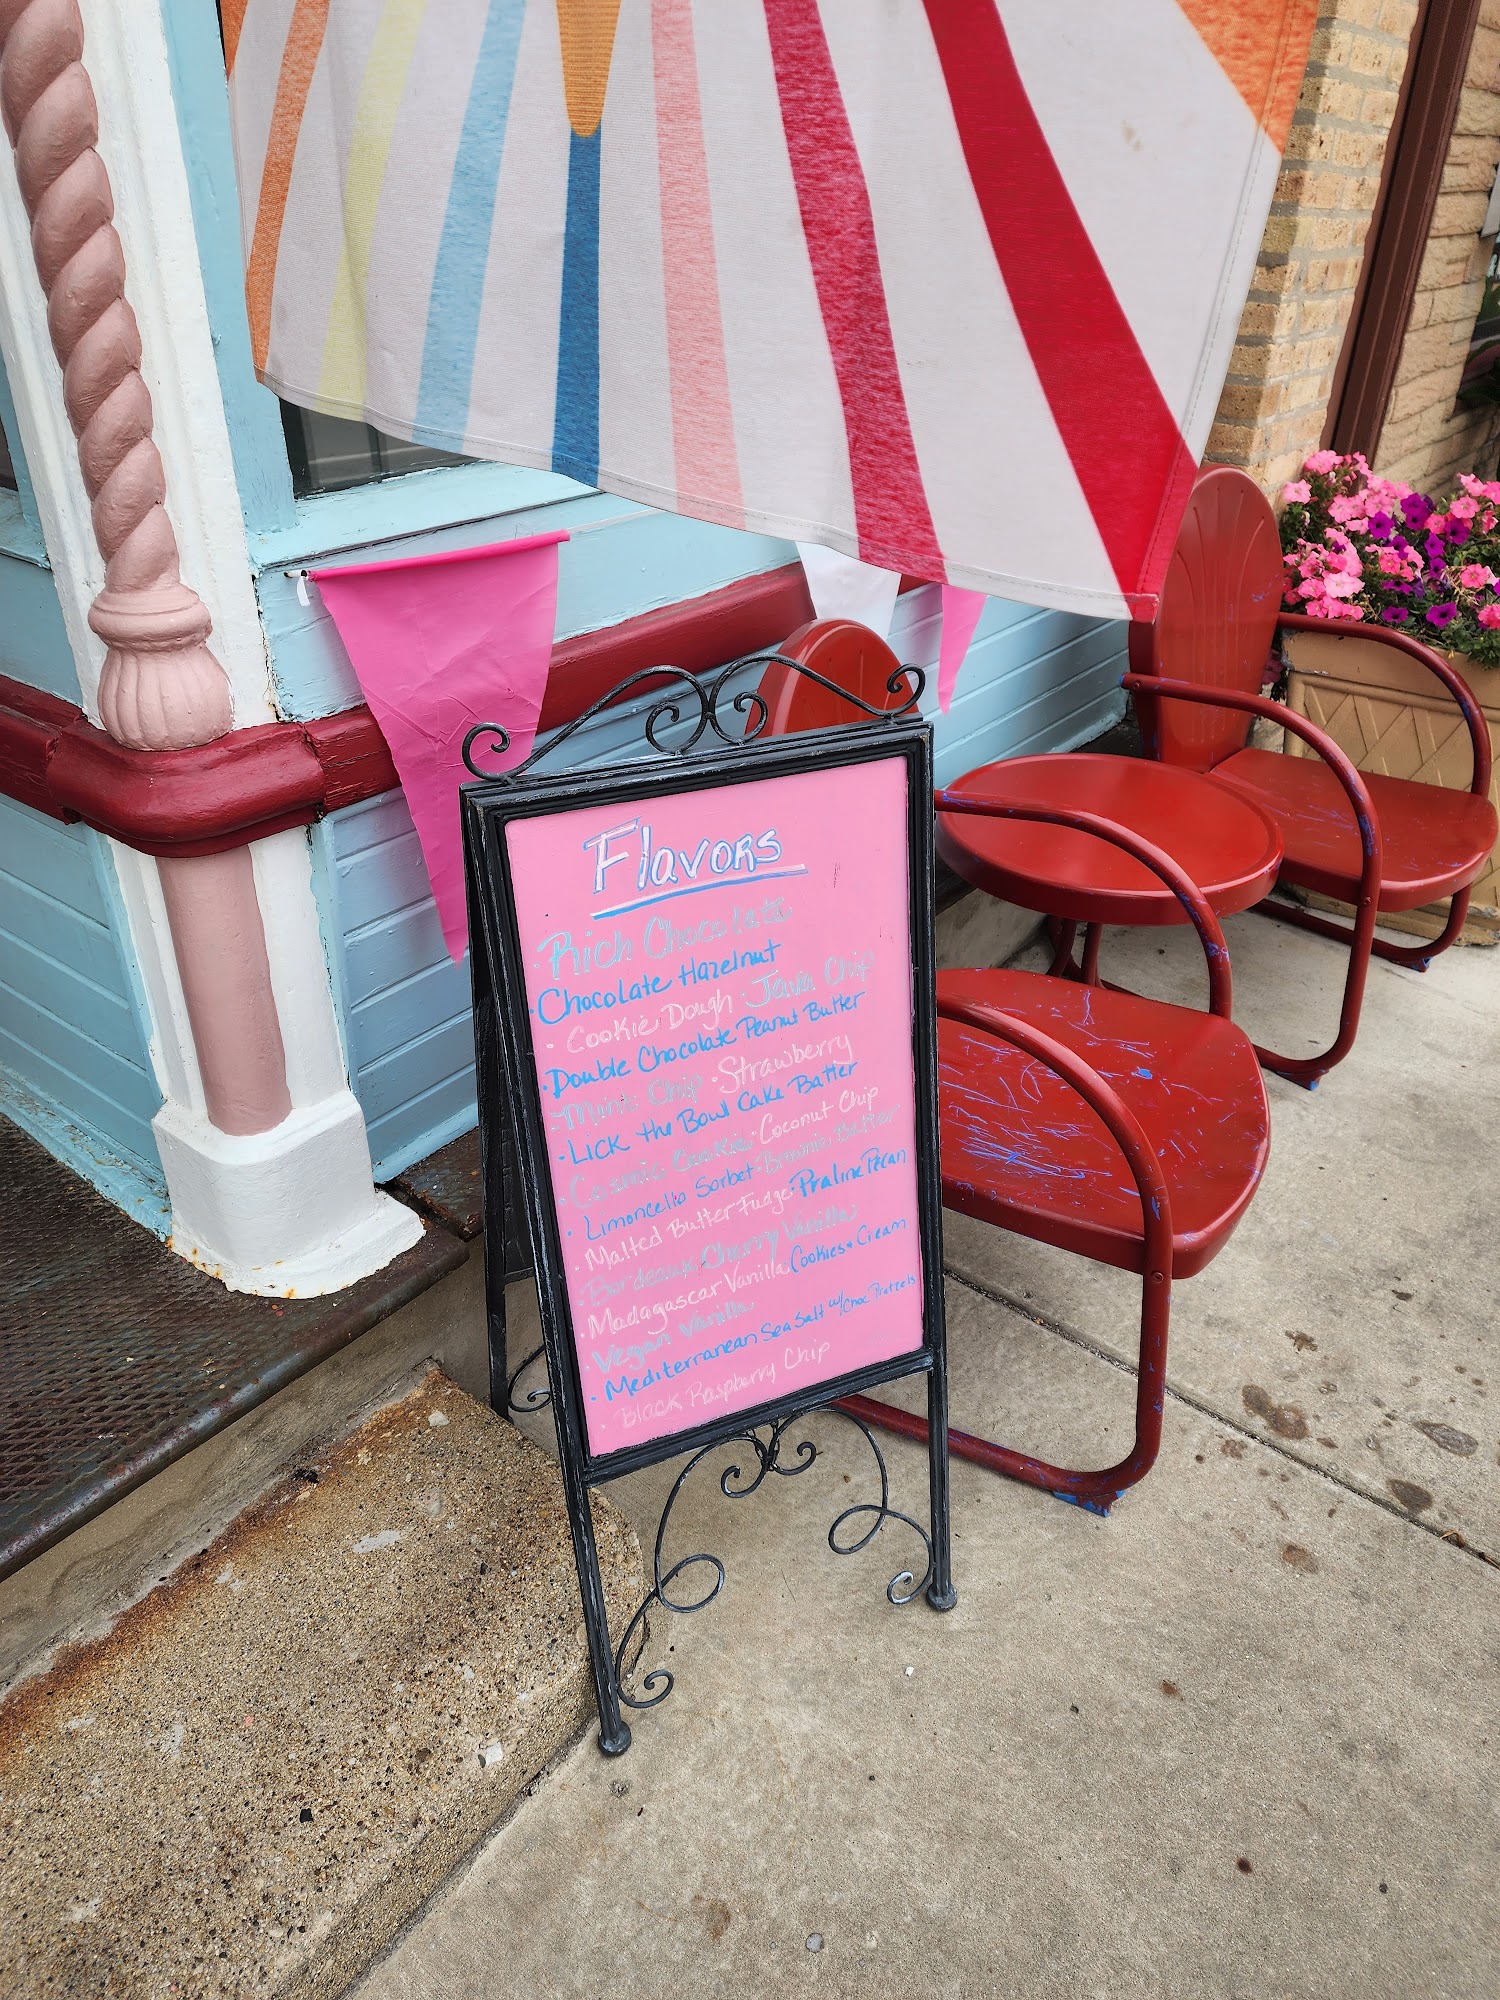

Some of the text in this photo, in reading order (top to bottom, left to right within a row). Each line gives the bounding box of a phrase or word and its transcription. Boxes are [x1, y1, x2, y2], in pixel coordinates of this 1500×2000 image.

[538, 897, 792, 980] Rich Chocolate
[538, 939, 783, 1024] Chocolate Hazelnut
[545, 991, 866, 1098] Double Chocolate Peanut Butter
[567, 950, 876, 1053] Cookie Dough Java Chip
[550, 1035, 853, 1130] Mint Chip Strawberry
[635, 1120, 673, 1143] the
[676, 1100, 730, 1134] Bowl
[737, 1084, 785, 1112] Cake
[787, 1061, 858, 1094] Batter
[569, 1086, 879, 1208] Cosmic Cookie Coconut Chip
[584, 1104, 900, 1241] Limoncello Sorbet Brownie Batter
[579, 1203, 858, 1306] Bordeaux Cherry Vanilla
[584, 1147, 907, 1271] Malted Butter Fudge Praline Pecan
[587, 1280, 723, 1340] Madagascar
[724, 1259, 790, 1293] Vanilla
[791, 1243, 846, 1274] Cookies
[856, 1218, 907, 1247] Cream
[592, 1333, 672, 1373] Vegan
[604, 1333, 758, 1402] Mediterranean
[760, 1322, 792, 1342] Sea
[794, 1303, 825, 1329] Salt
[868, 1273, 916, 1298] Pretzels
[613, 1339, 830, 1428] Black Raspberry Chip
